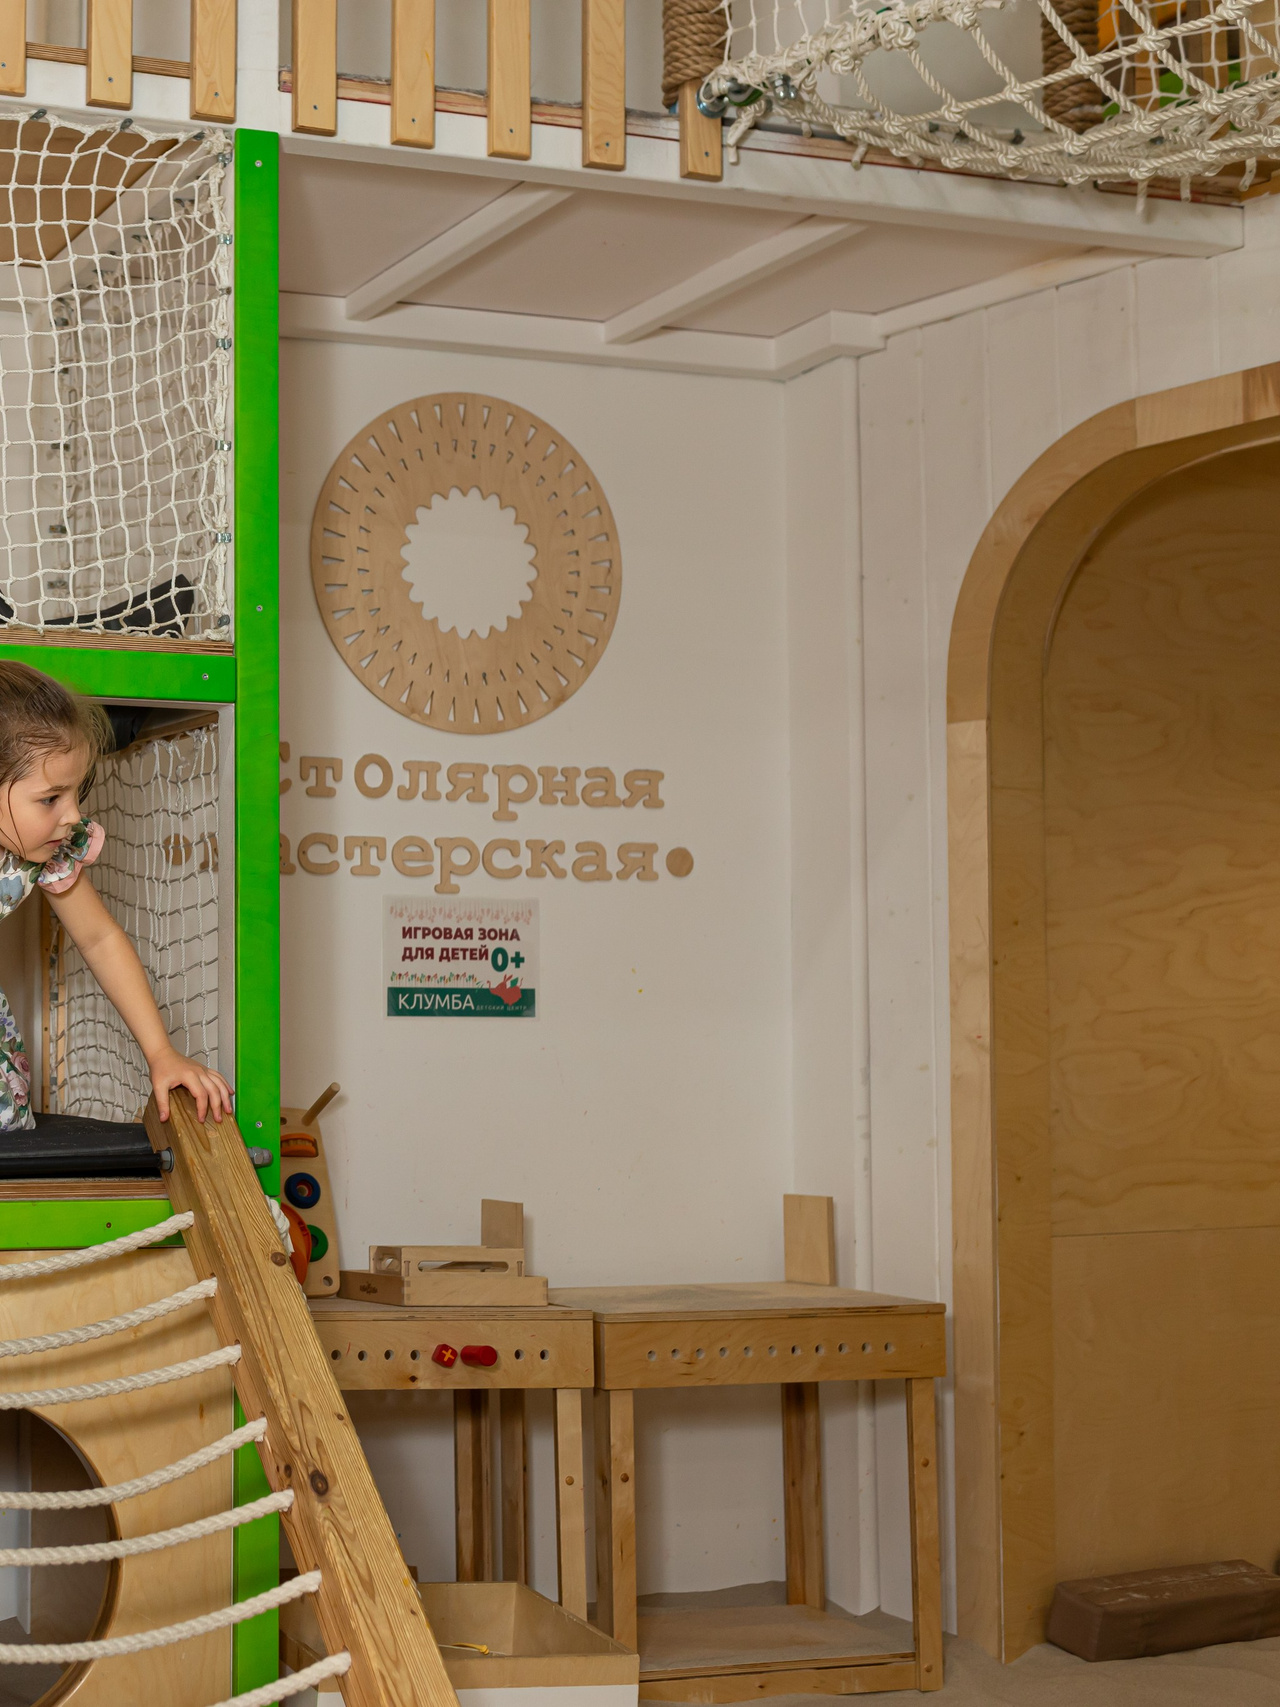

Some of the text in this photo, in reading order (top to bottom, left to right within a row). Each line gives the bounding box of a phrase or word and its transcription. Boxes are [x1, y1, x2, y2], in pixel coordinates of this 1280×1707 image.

[401, 926, 521, 942] ИГРОВАЯ ЗОНА
[401, 944, 526, 973] ДЛЯ ДЕТЕЙ 0+
[397, 992, 475, 1011] КЛУМБА
